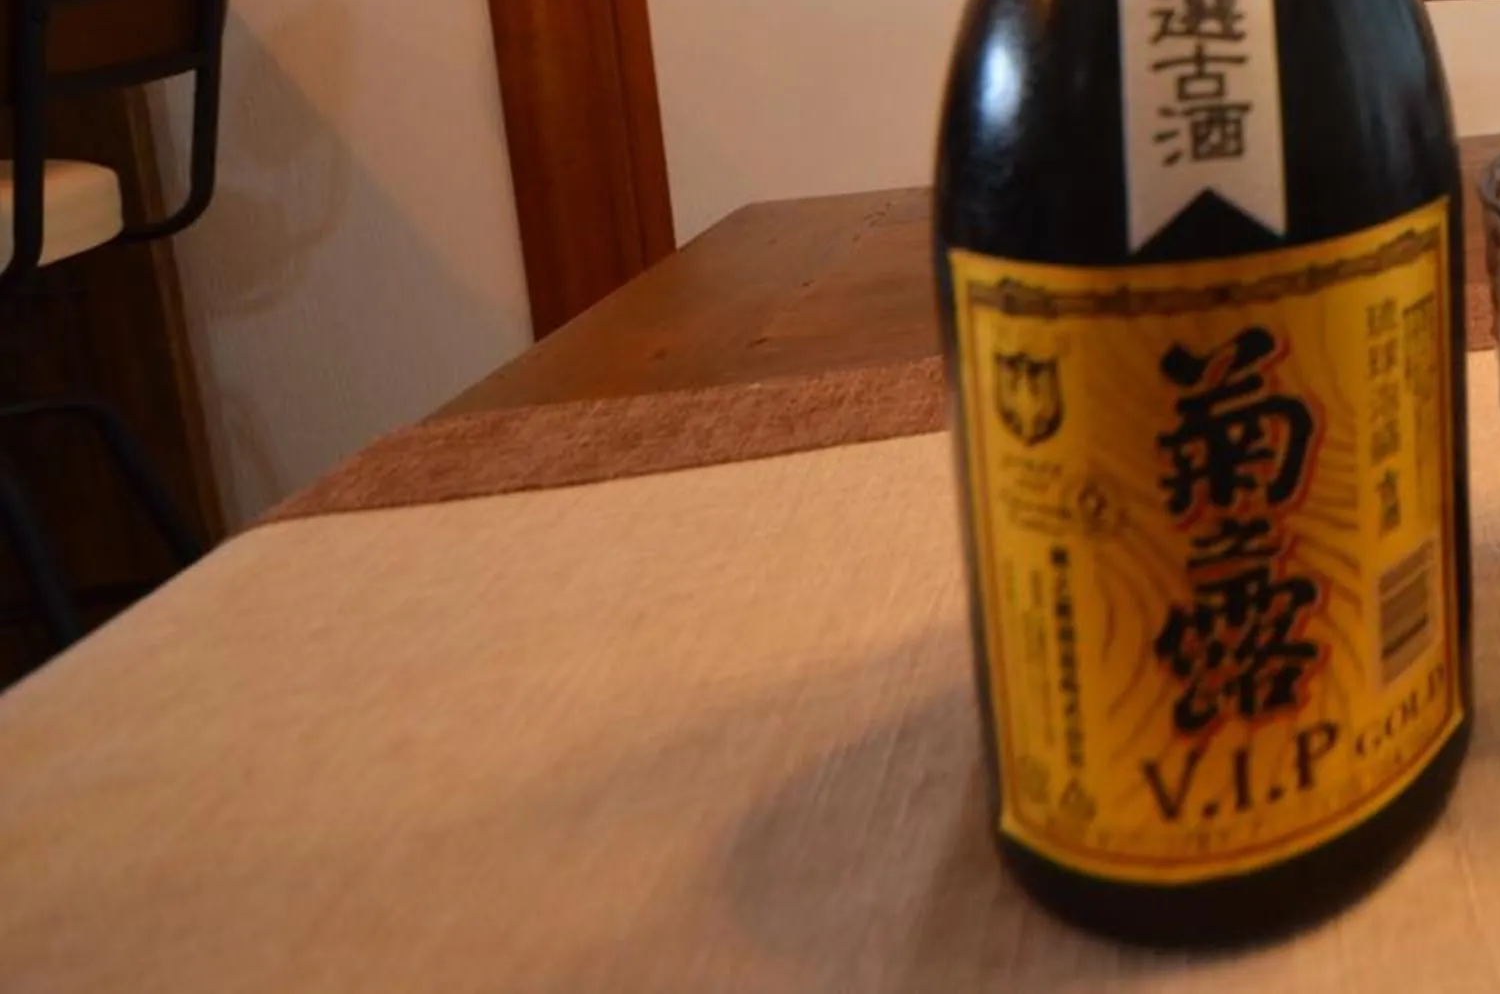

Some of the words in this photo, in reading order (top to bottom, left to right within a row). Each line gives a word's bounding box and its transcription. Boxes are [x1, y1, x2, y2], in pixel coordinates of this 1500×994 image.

[1155, 327, 1320, 733] 菊之露
[1141, 721, 1338, 824] V.I.P
